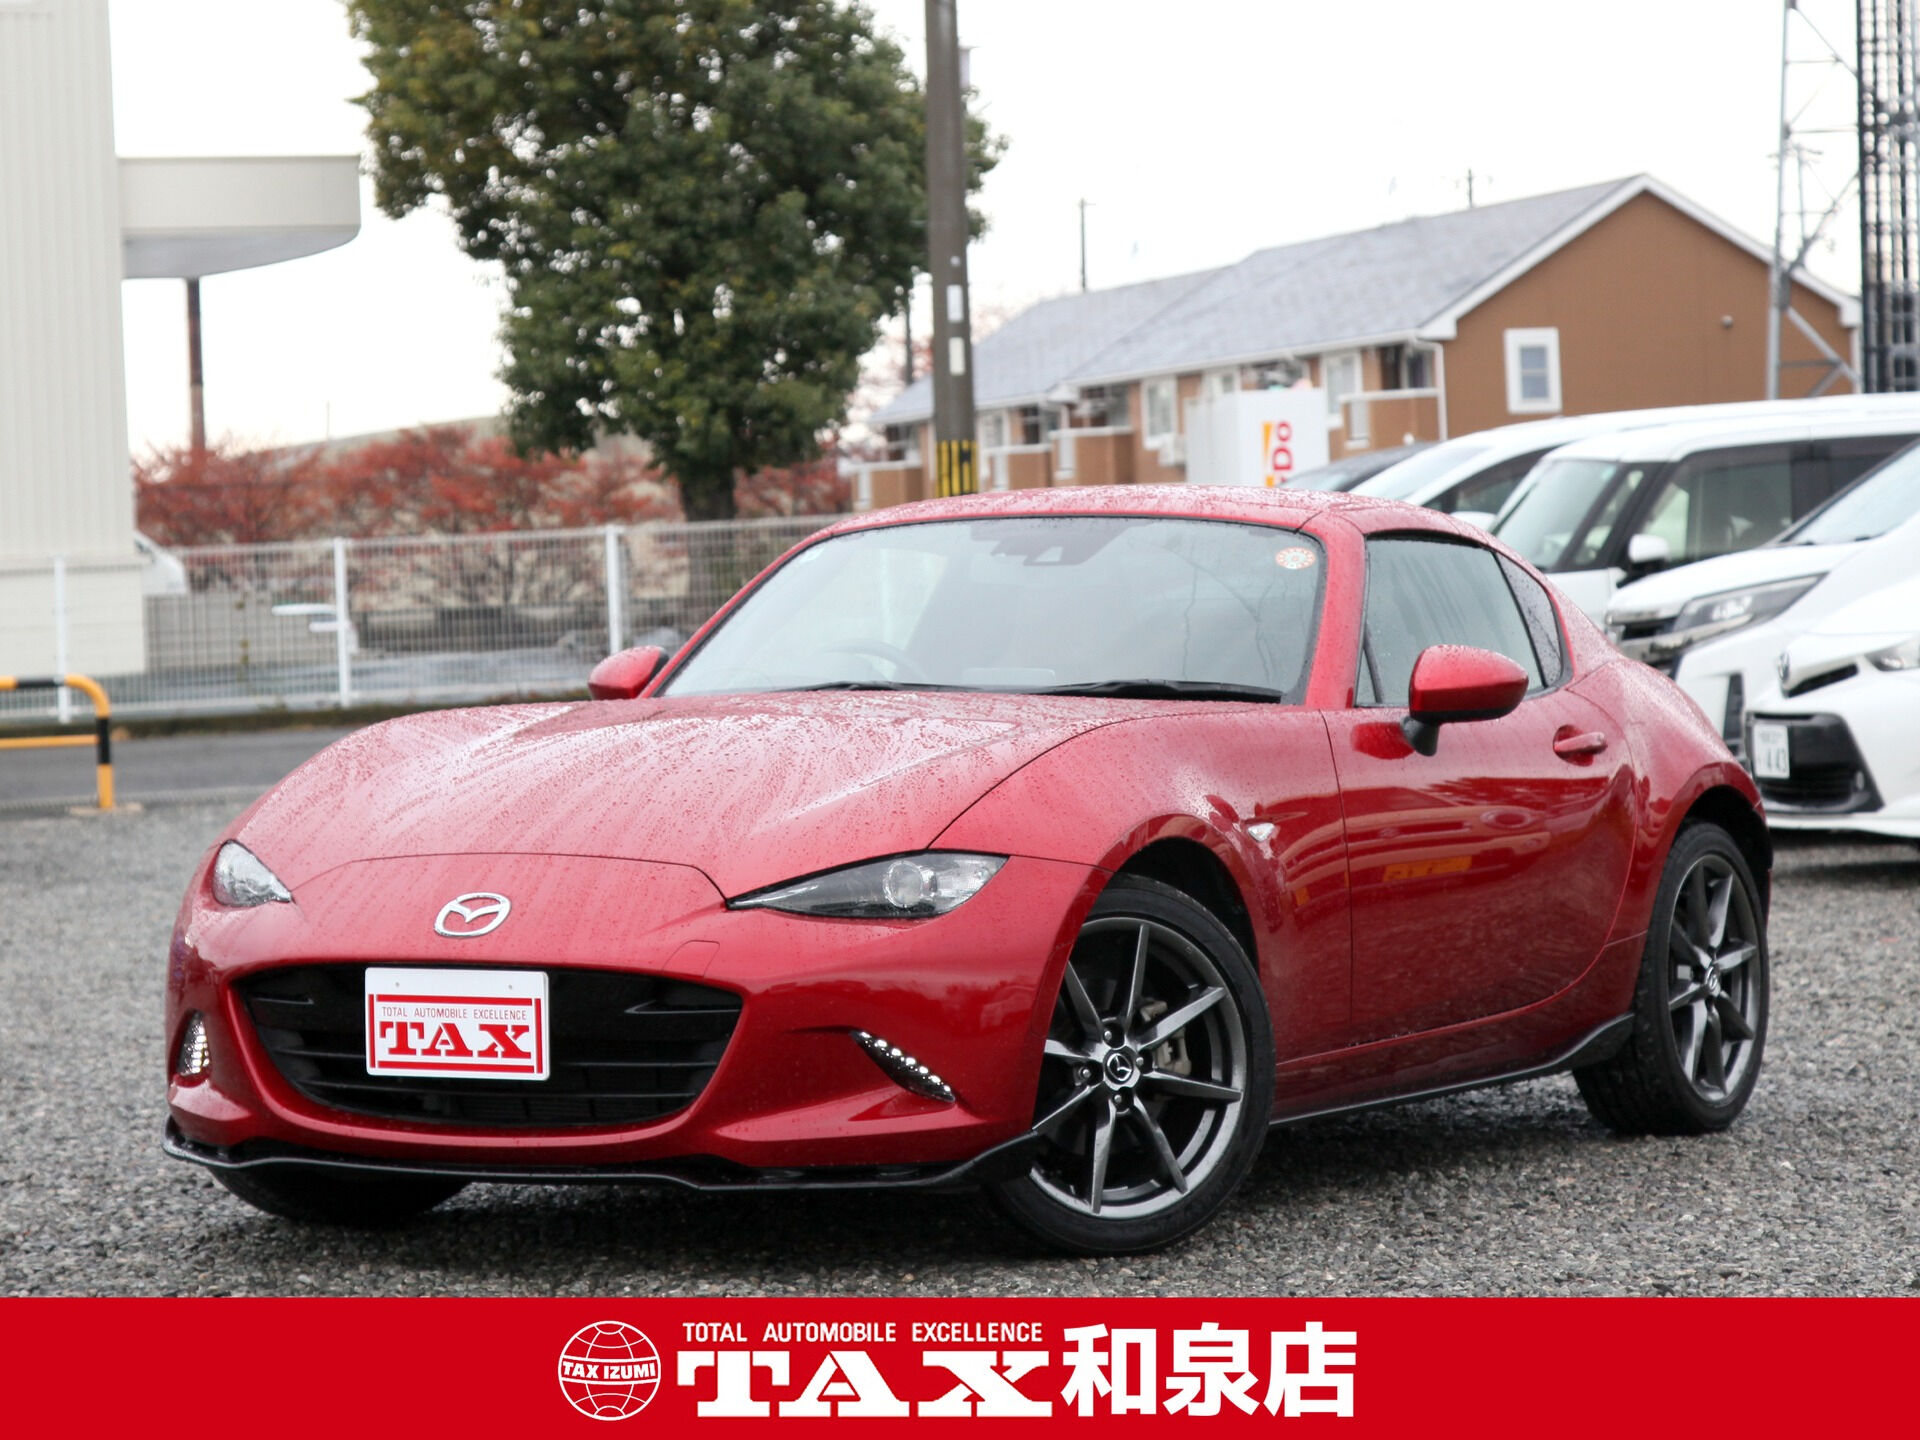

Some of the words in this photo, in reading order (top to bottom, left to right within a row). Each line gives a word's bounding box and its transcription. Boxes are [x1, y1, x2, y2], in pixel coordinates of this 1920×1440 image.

[382, 1007, 408, 1017] TOTAL
[414, 1008, 468, 1019] AUTOMOBILE
[474, 1009, 528, 1020] EXCELLENCE
[380, 1021, 532, 1059] TAX
